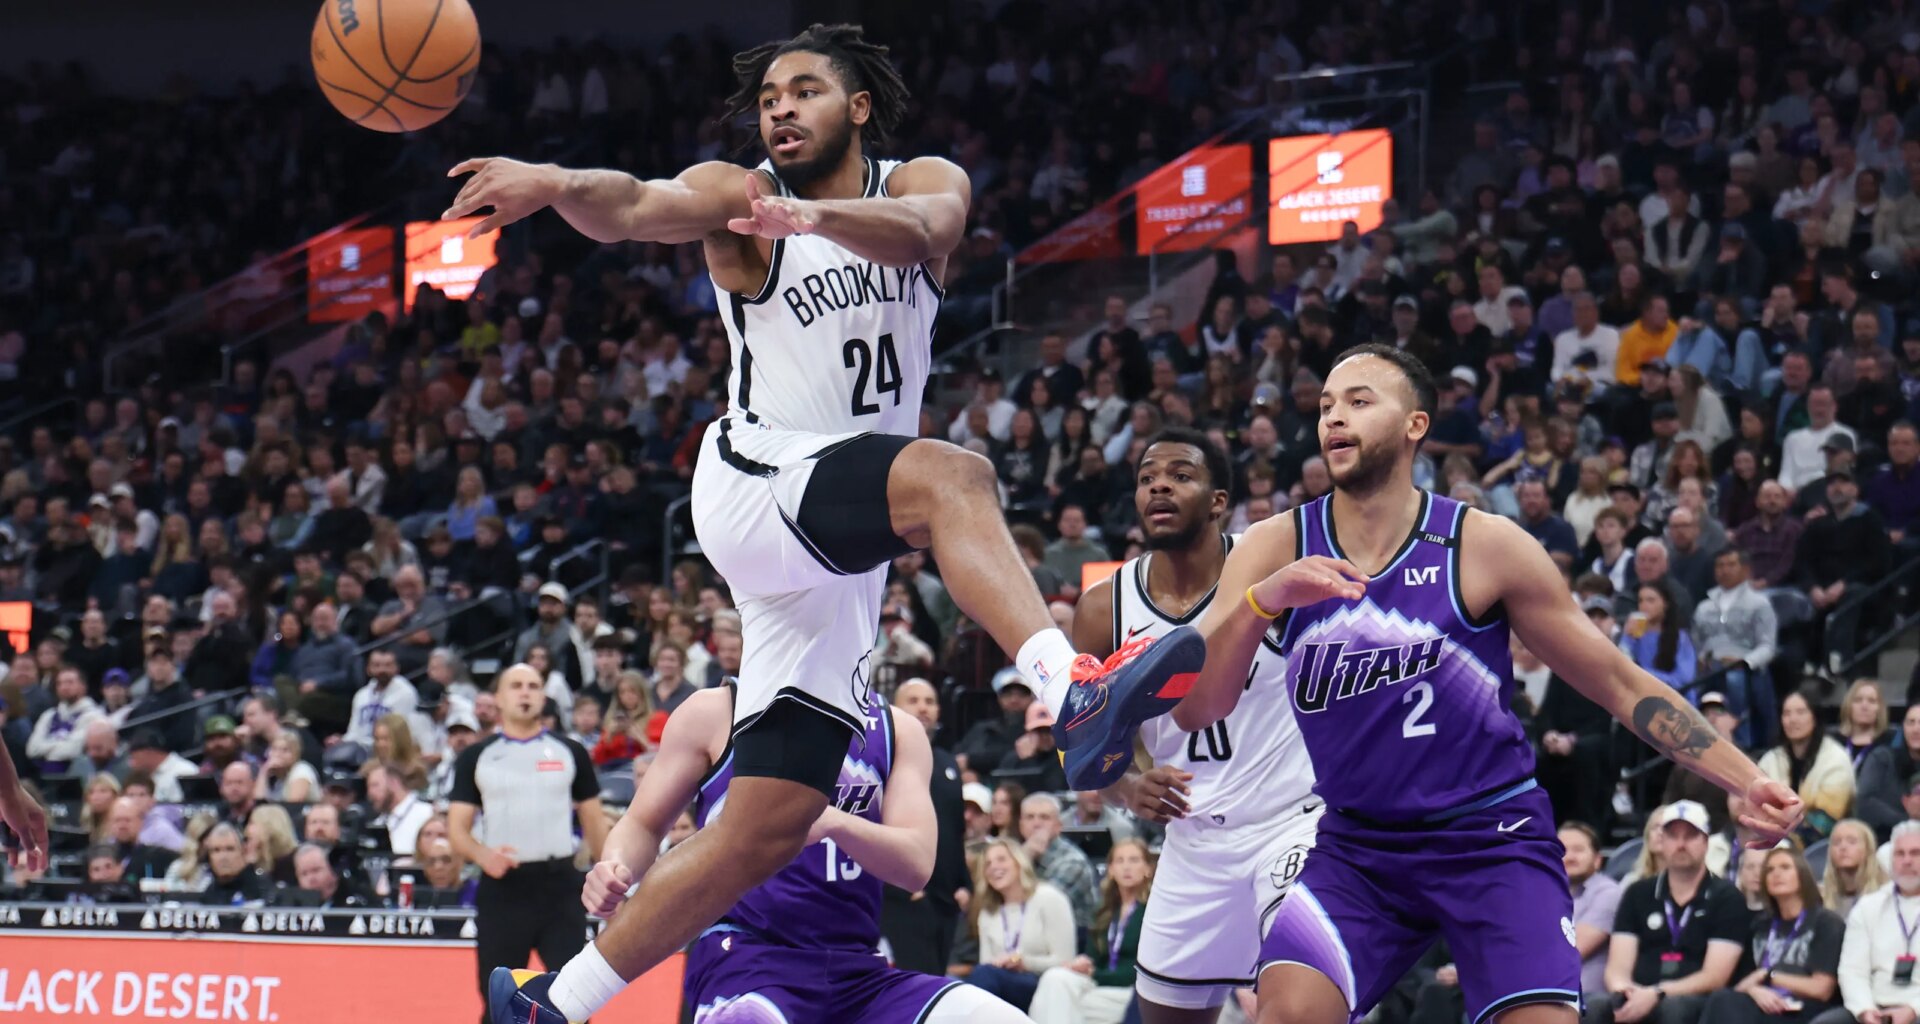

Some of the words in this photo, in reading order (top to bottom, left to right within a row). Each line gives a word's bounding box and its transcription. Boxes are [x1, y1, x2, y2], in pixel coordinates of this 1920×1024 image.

[843, 333, 902, 416] 24
[1424, 533, 1446, 545] FRANK
[1404, 565, 1441, 586] LVT
[1294, 633, 1450, 713] UTAH
[1403, 681, 1436, 738] 2
[59, 905, 119, 926] DELTA
[159, 907, 221, 929] DELTA
[261, 911, 325, 932] DELTA
[369, 914, 435, 935] DELTA
